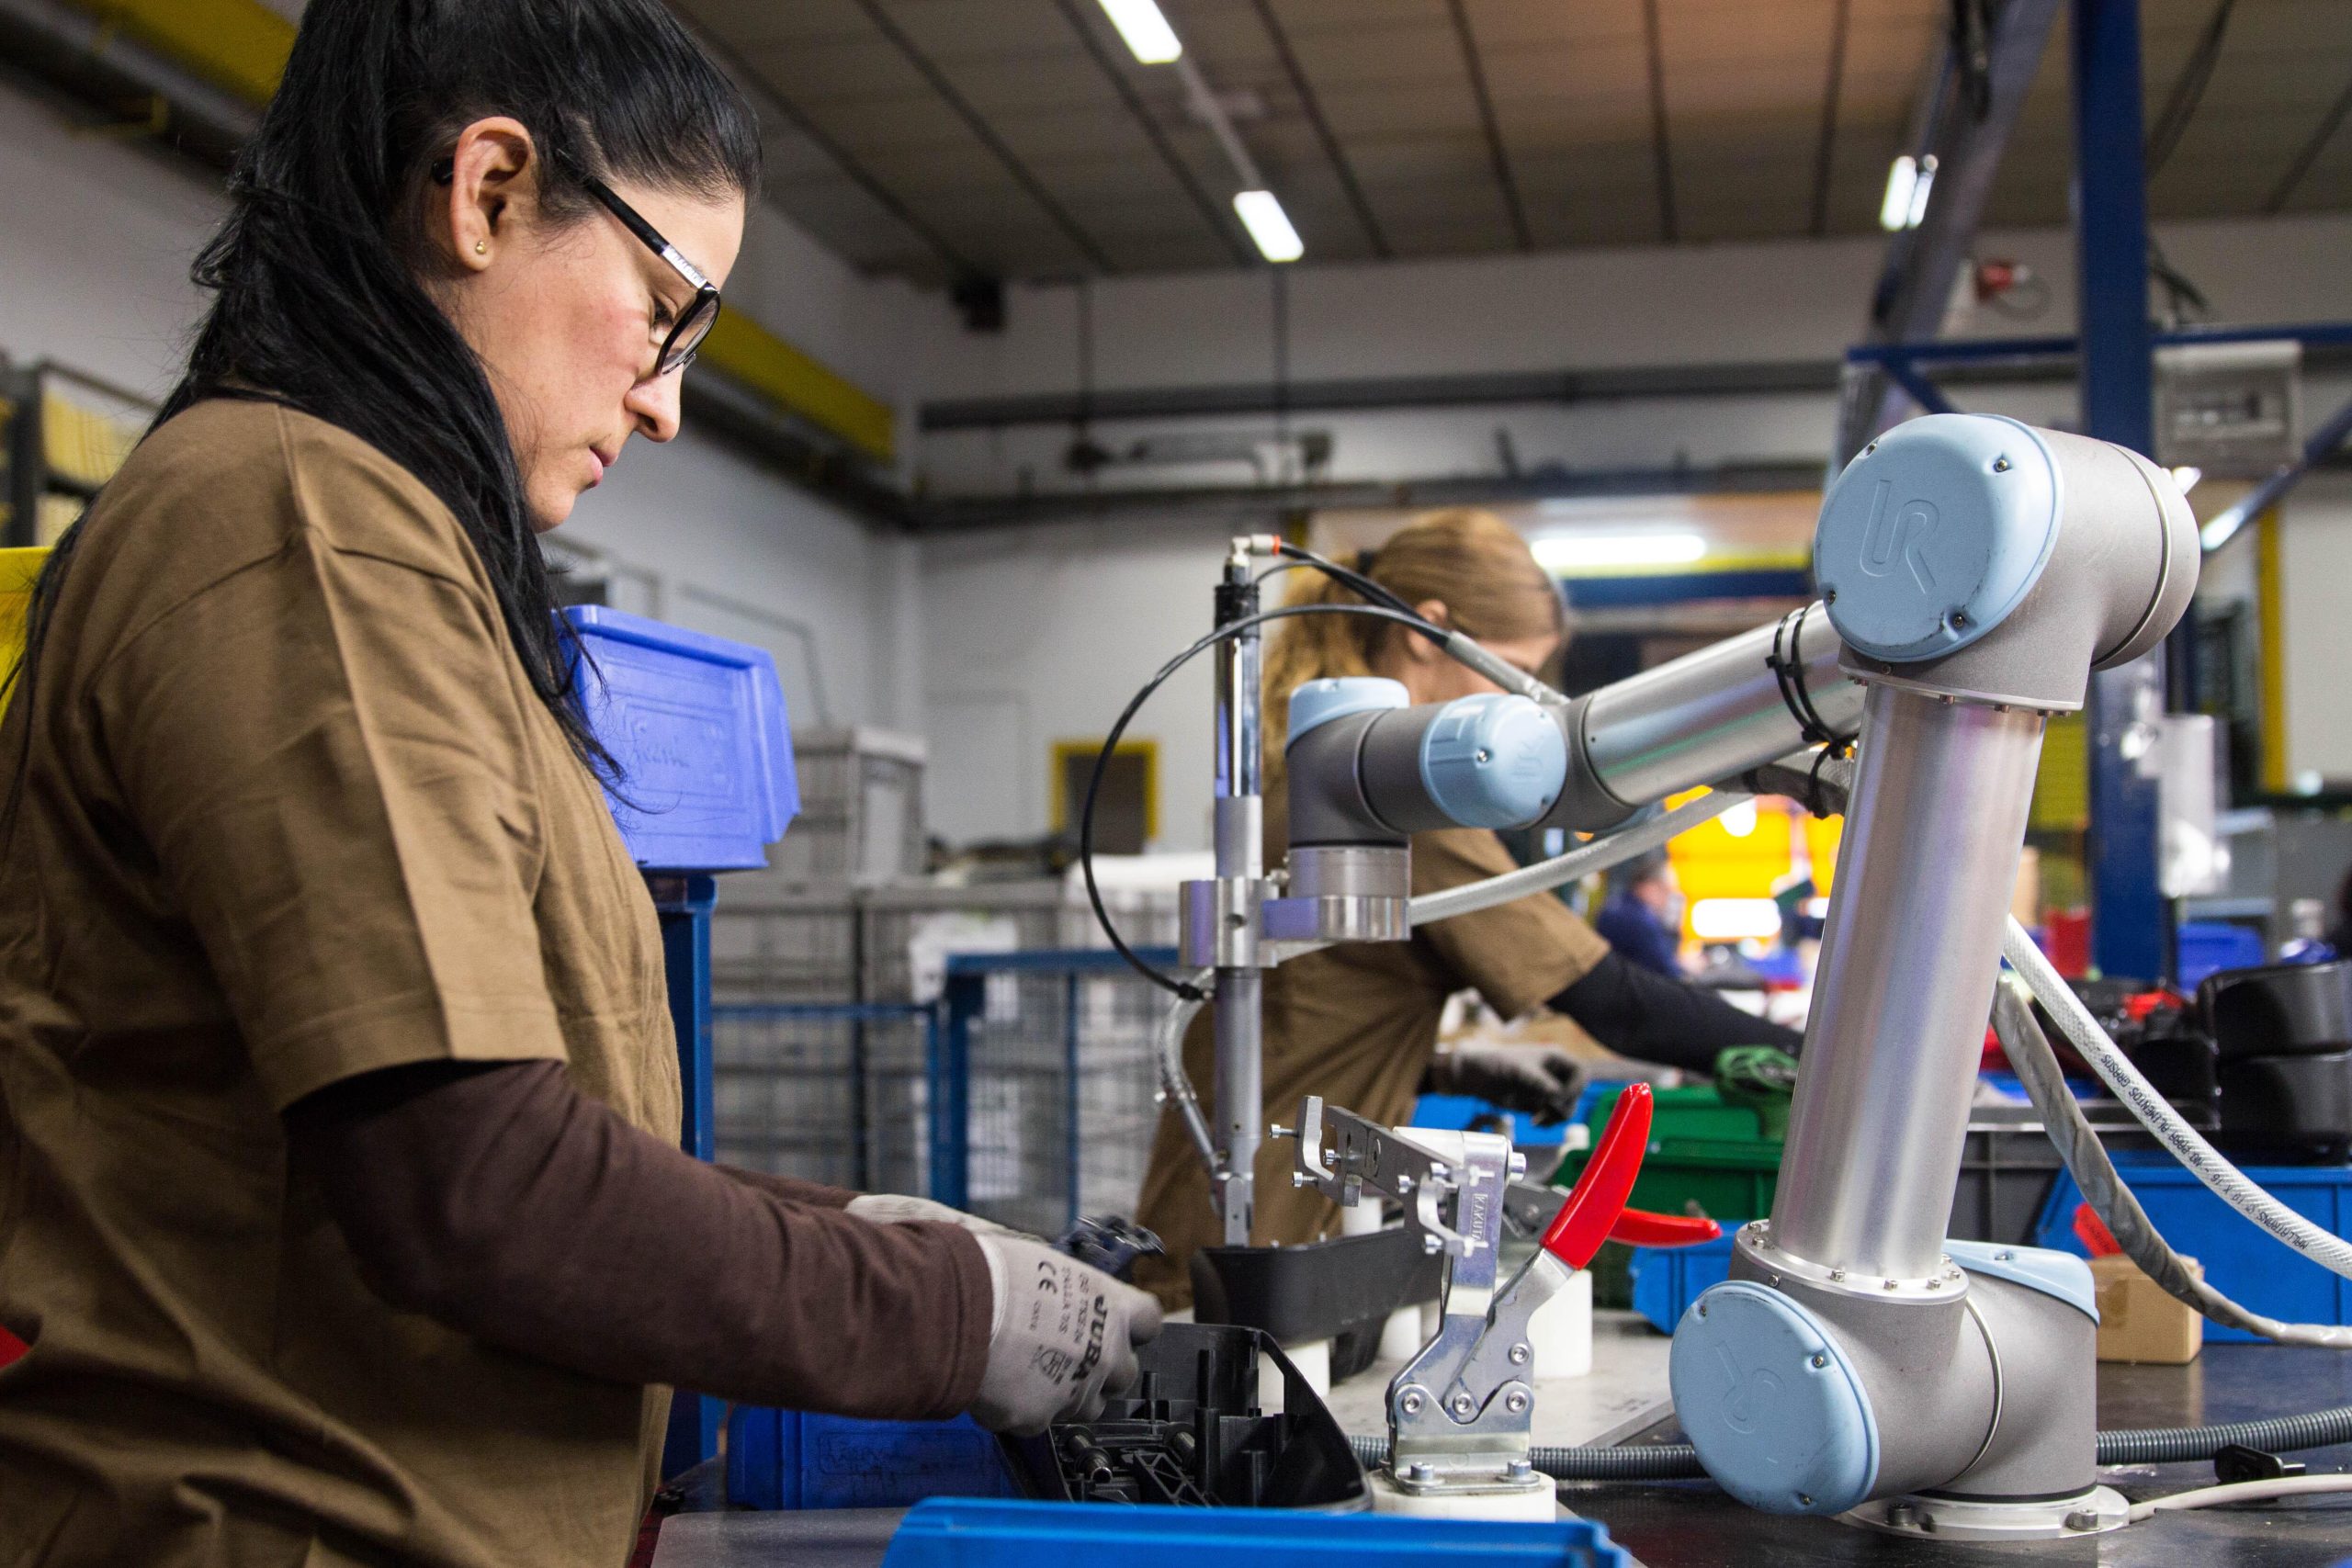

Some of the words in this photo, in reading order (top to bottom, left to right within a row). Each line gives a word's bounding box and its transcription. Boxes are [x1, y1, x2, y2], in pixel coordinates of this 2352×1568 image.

[1859, 479, 1940, 595] UR
[2100, 1054, 2130, 1088] GRASOS
[2128, 1087, 2168, 1133] ALIMENTOS
[2168, 1132, 2191, 1155] PARA
[2189, 1152, 2203, 1167] NO
[2211, 1173, 2222, 1185] 16
[1038, 1260, 1058, 1294] CE
[1071, 1294, 1108, 1382] JUBA
